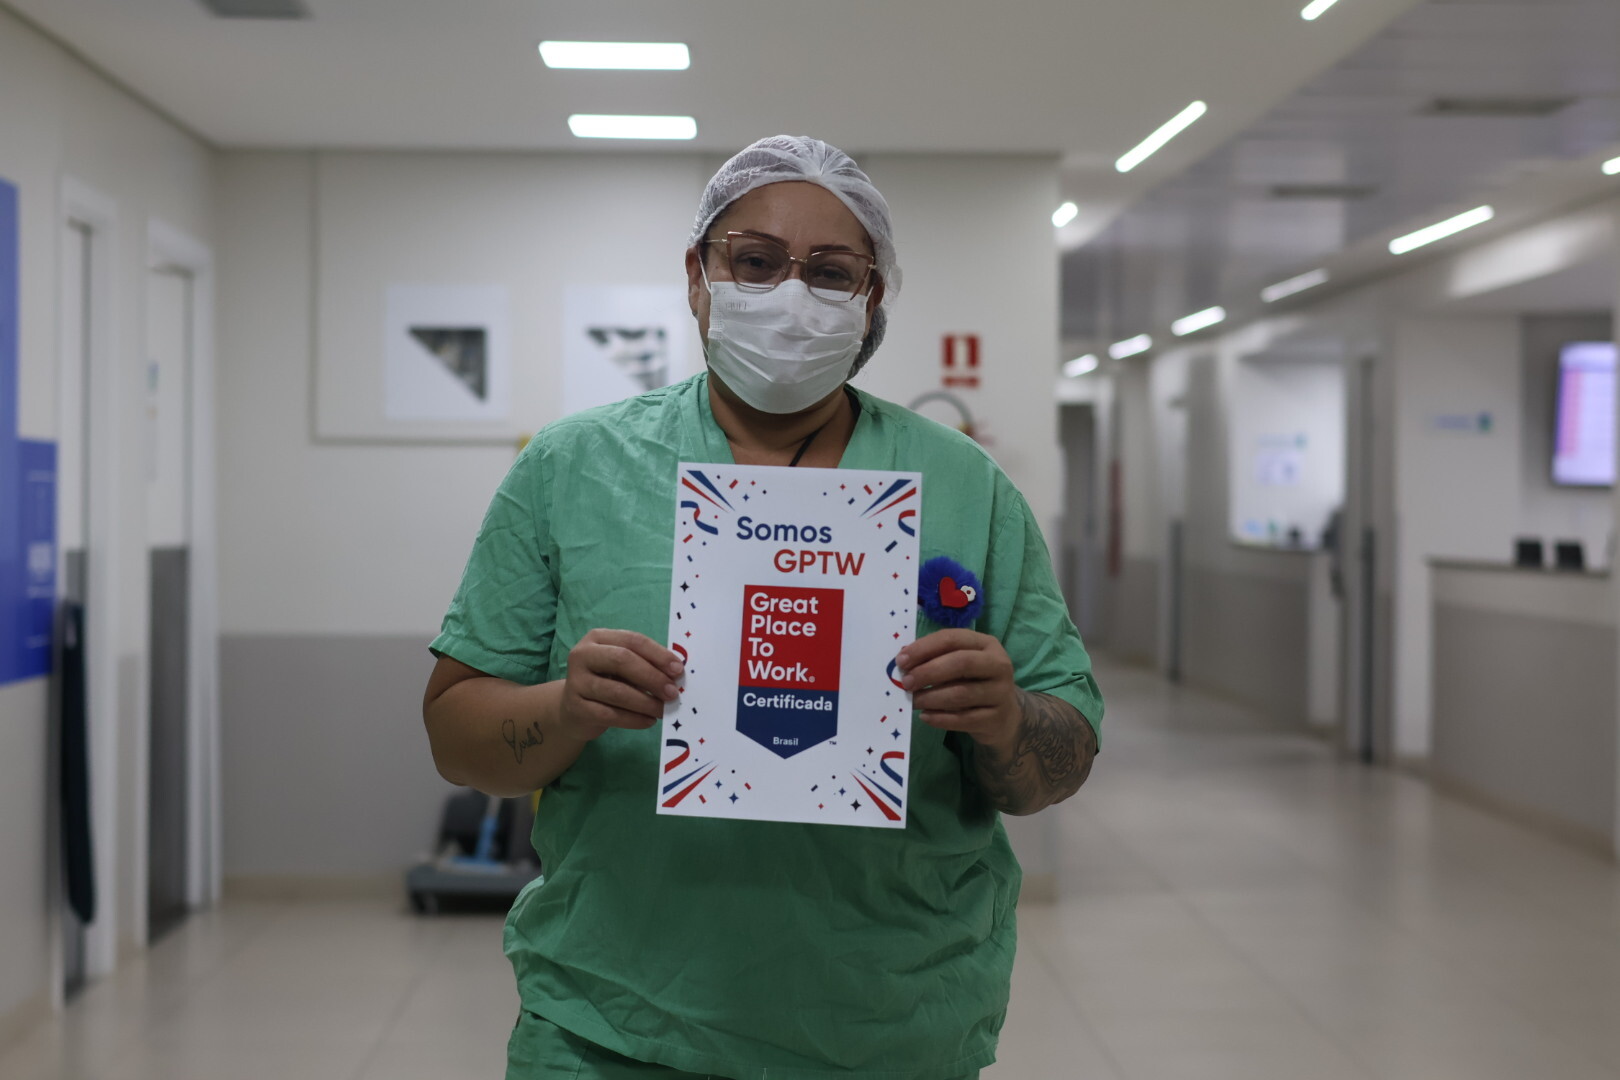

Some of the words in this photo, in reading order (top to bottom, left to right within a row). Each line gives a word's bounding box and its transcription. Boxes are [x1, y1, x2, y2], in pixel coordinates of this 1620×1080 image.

[736, 515, 833, 544] Somos
[773, 548, 866, 576] GPTW
[750, 592, 819, 614] Great
[750, 615, 817, 637] Place
[748, 637, 774, 658] To
[743, 692, 833, 711] Certificada
[773, 737, 799, 746] Brasil
